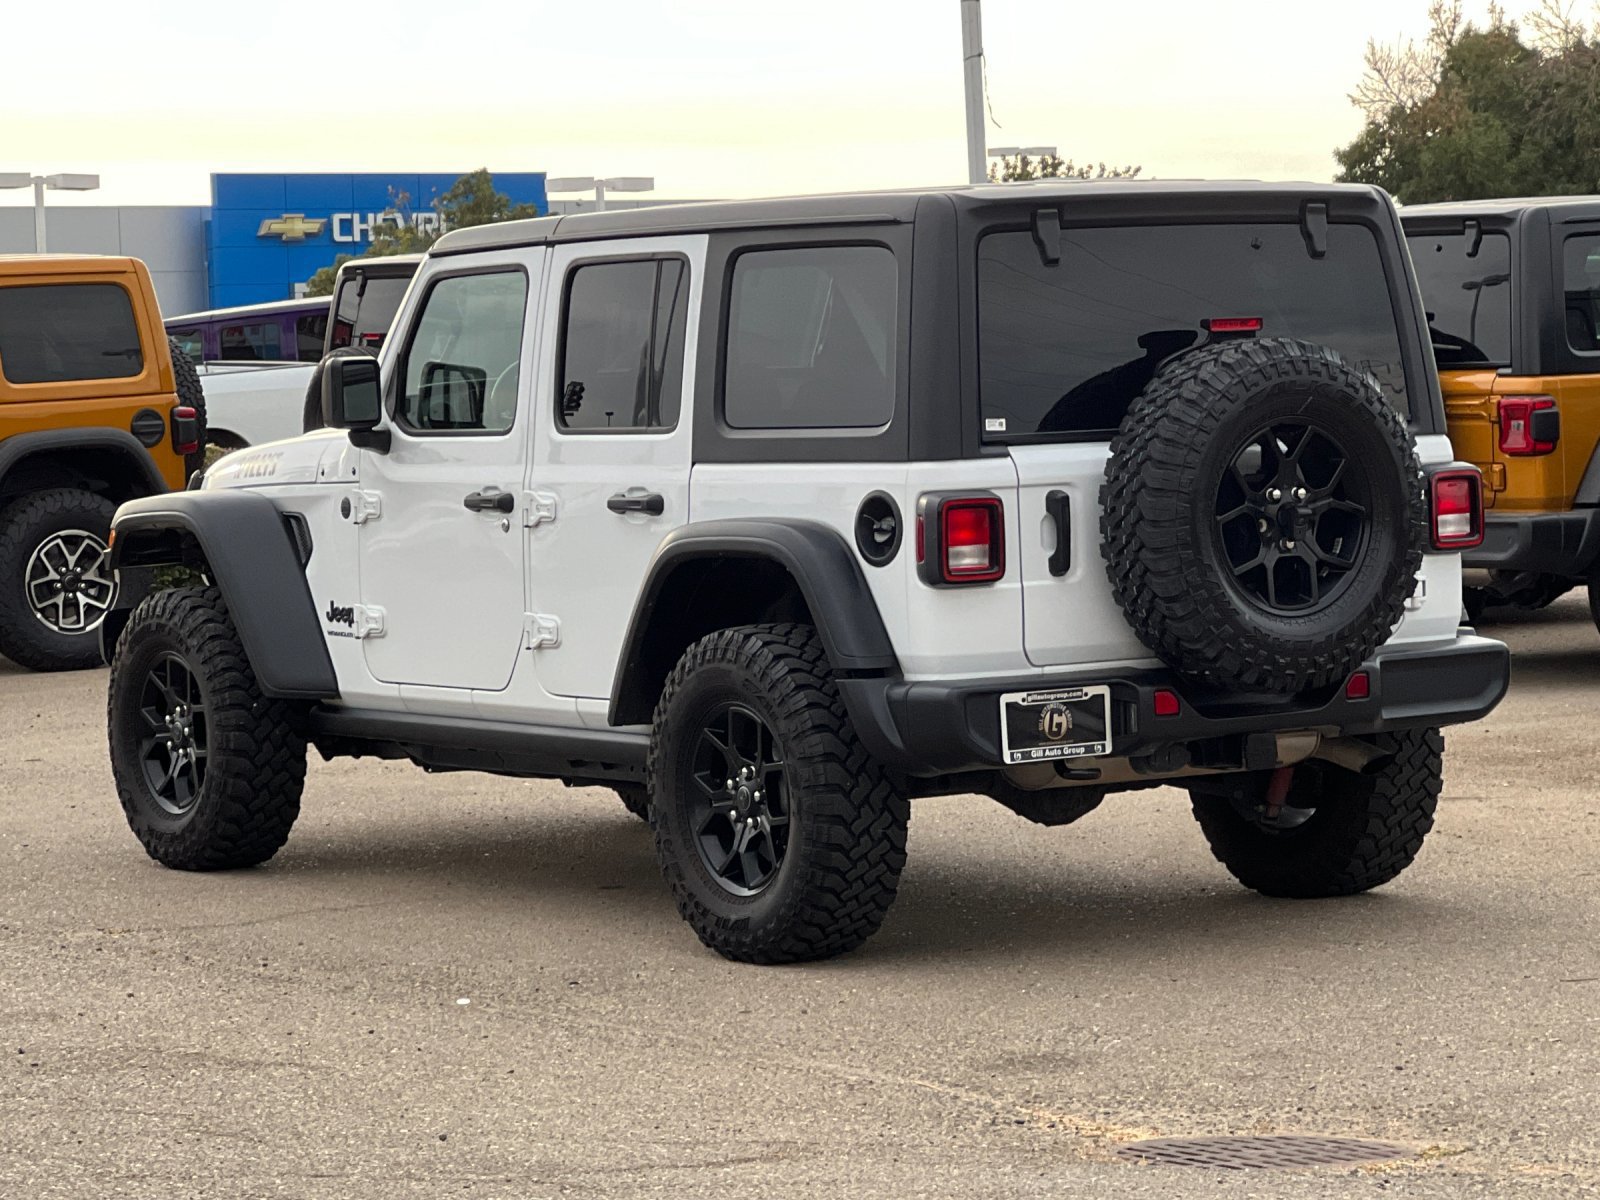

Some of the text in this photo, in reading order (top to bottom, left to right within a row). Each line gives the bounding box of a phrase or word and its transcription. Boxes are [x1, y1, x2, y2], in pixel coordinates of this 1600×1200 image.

[326, 599, 355, 628] Jeep
[1027, 692, 1082, 702] gillautogroup.com
[1031, 749, 1044, 758] Gill
[1045, 748, 1062, 757] Auto
[1063, 745, 1085, 755] Group
